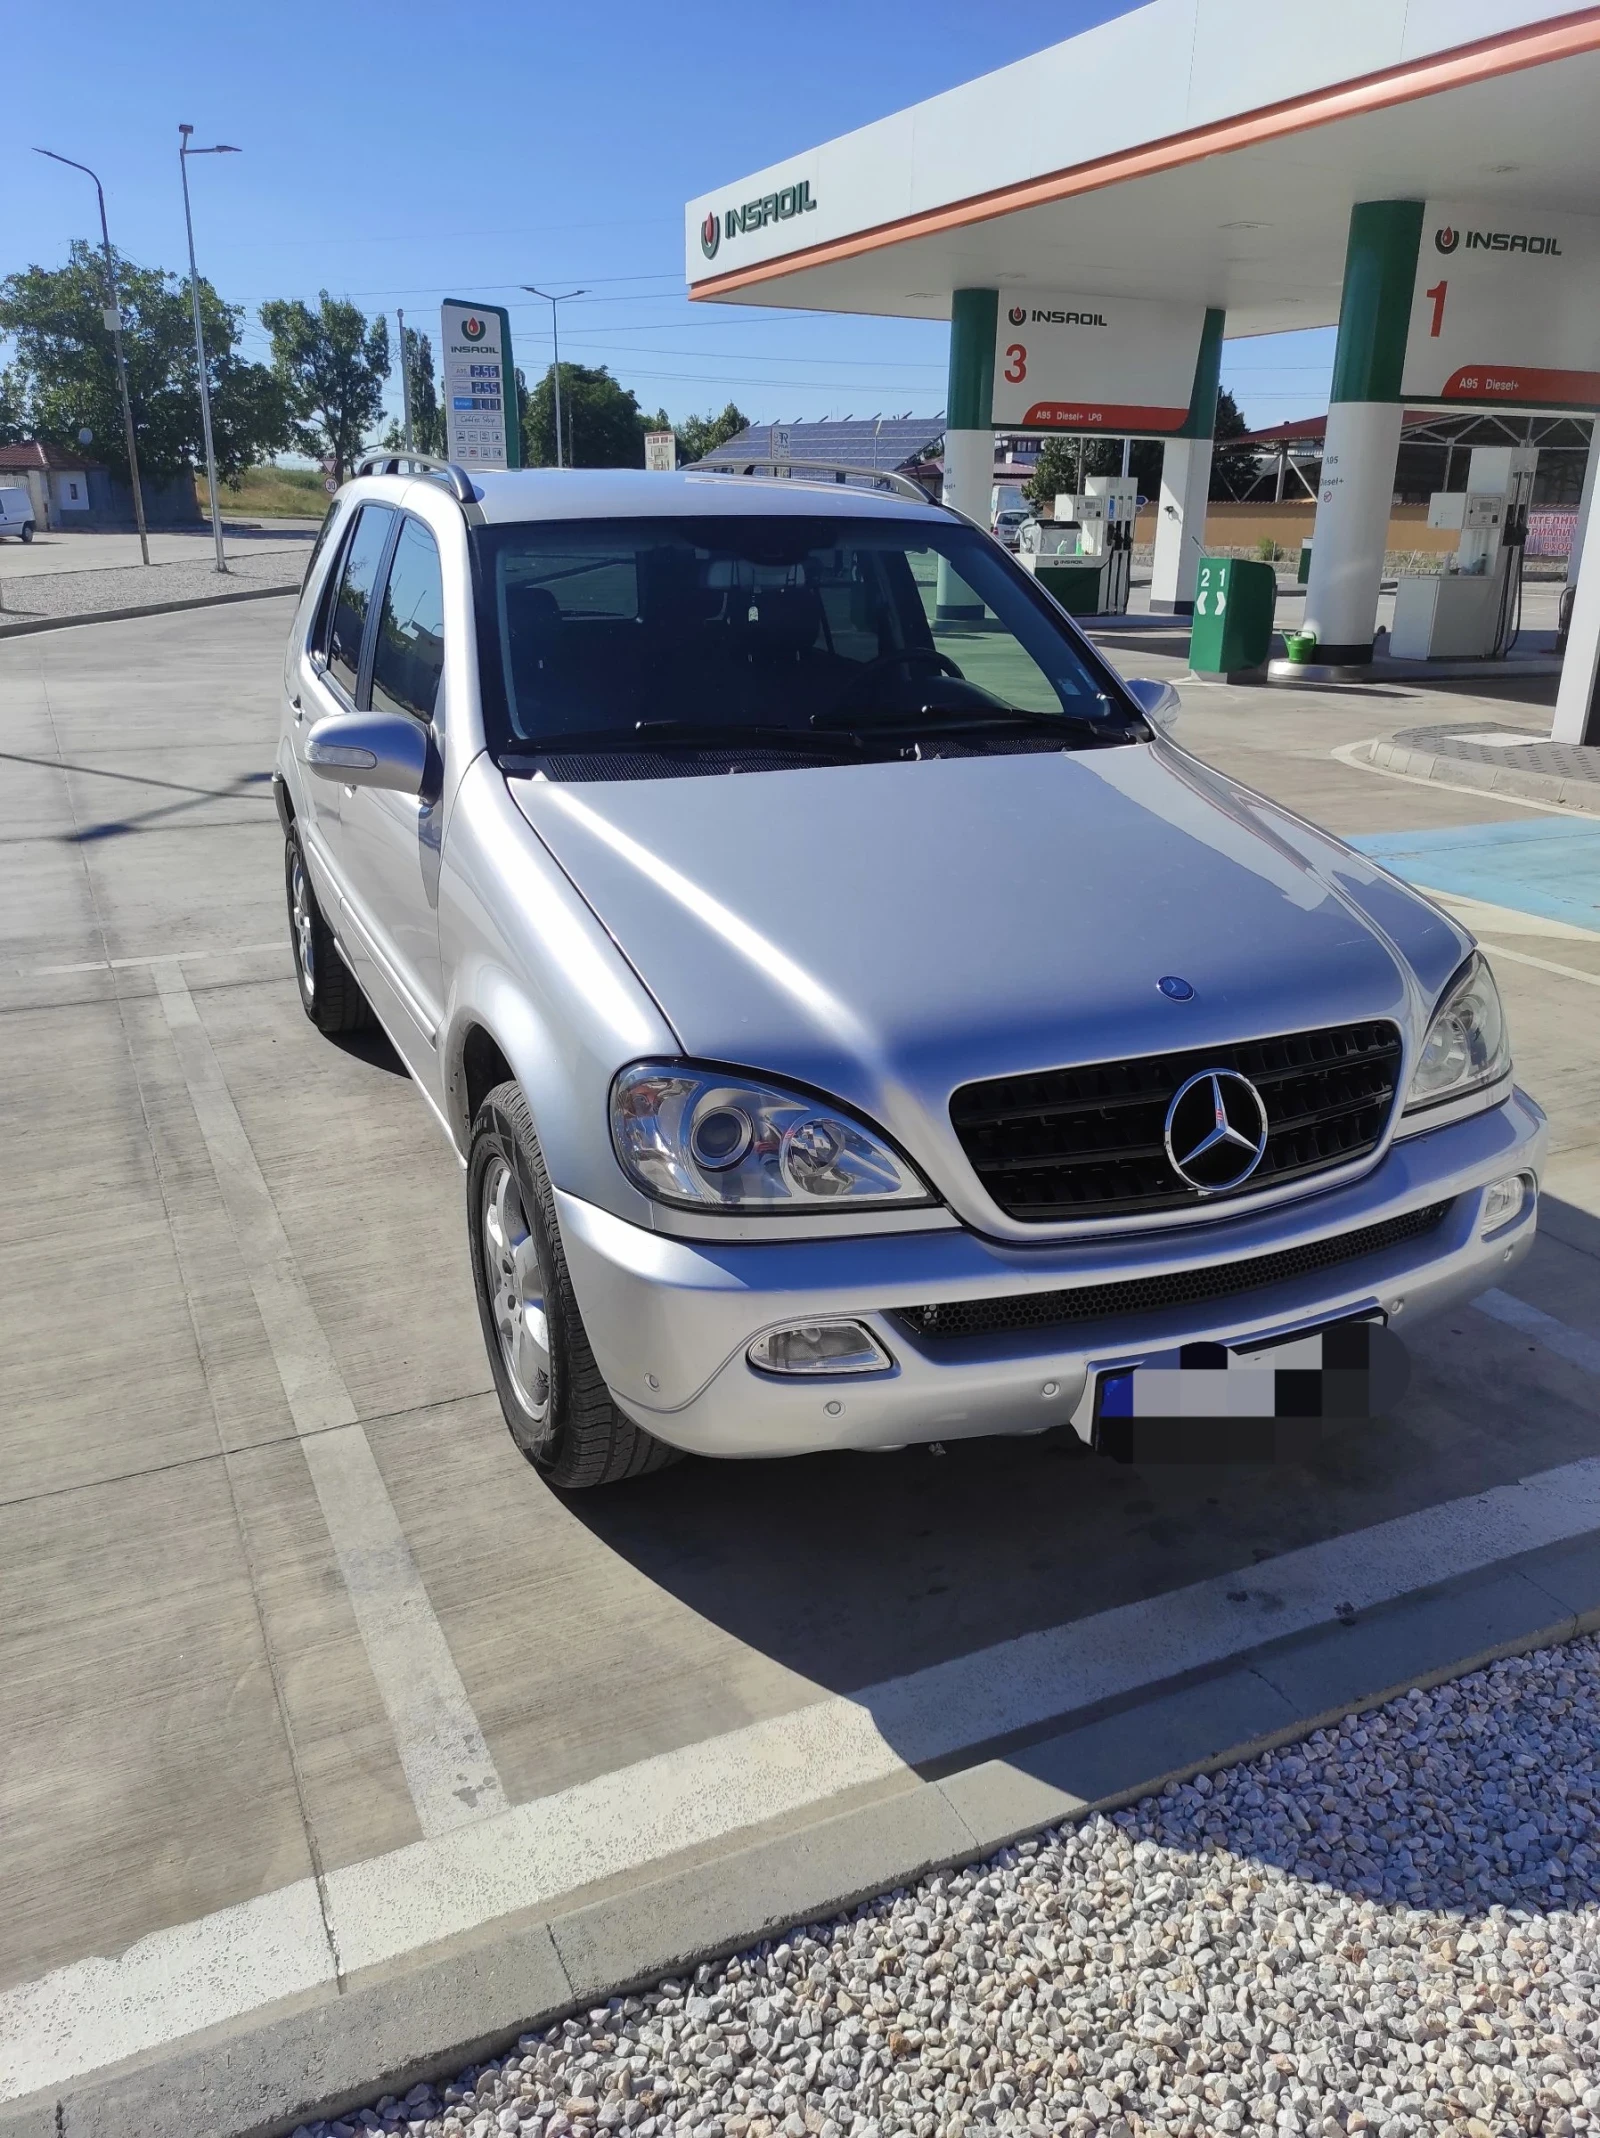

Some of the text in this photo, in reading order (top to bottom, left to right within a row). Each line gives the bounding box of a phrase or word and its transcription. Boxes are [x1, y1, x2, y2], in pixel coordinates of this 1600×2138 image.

[725, 180, 817, 240] INSAOIL
[1465, 231, 1562, 256] INSAOIL
[1426, 280, 1448, 337] 1
[1032, 310, 1108, 327] INSAOIL
[450, 346, 499, 354] INSAOIL
[1004, 343, 1027, 384] 3
[474, 366, 497, 378] 2.56
[1459, 377, 1519, 391] A95 Diesel+
[1036, 411, 1051, 420] A95
[1056, 411, 1084, 421] Diesel+
[1529, 516, 1578, 525] ИТЕЛНИ
[1531, 528, 1571, 537] РИАЛИ
[1201, 568, 1226, 587] 2 1
